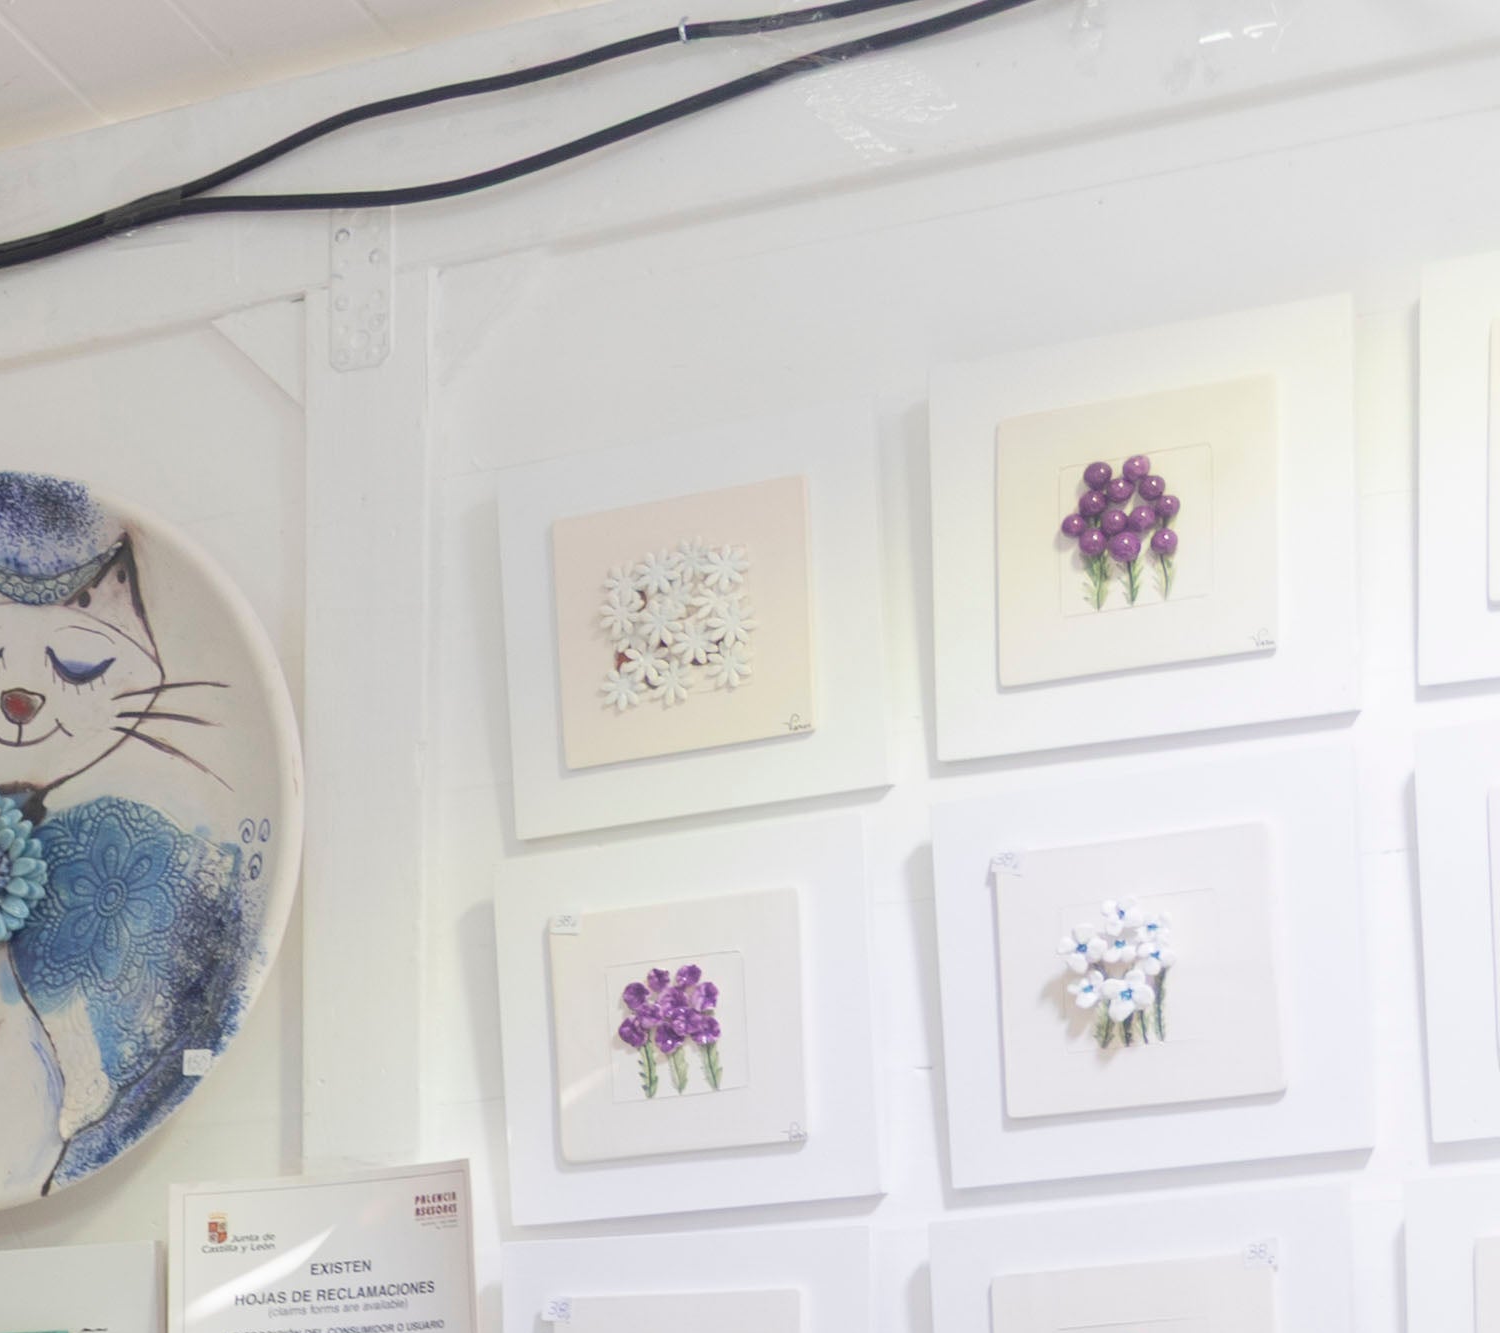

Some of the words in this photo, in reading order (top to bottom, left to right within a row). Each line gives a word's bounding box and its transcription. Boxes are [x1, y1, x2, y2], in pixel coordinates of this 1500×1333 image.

[414, 1192, 456, 1205] PALENCIA
[414, 1204, 457, 1216] ASESORES
[231, 1234, 259, 1243] Junta
[262, 1233, 276, 1241] de
[202, 1245, 237, 1253] Castilla
[251, 1243, 275, 1251] León
[310, 1260, 372, 1275] EXISTEN
[235, 1292, 286, 1305] HOJAS
[292, 1290, 312, 1302] DE
[316, 1281, 436, 1301] RECLAMACIONES
[310, 1303, 339, 1314] forms
[343, 1303, 360, 1312] are
[397, 1322, 404, 1332] O
[407, 1319, 445, 1331] USUARIO
